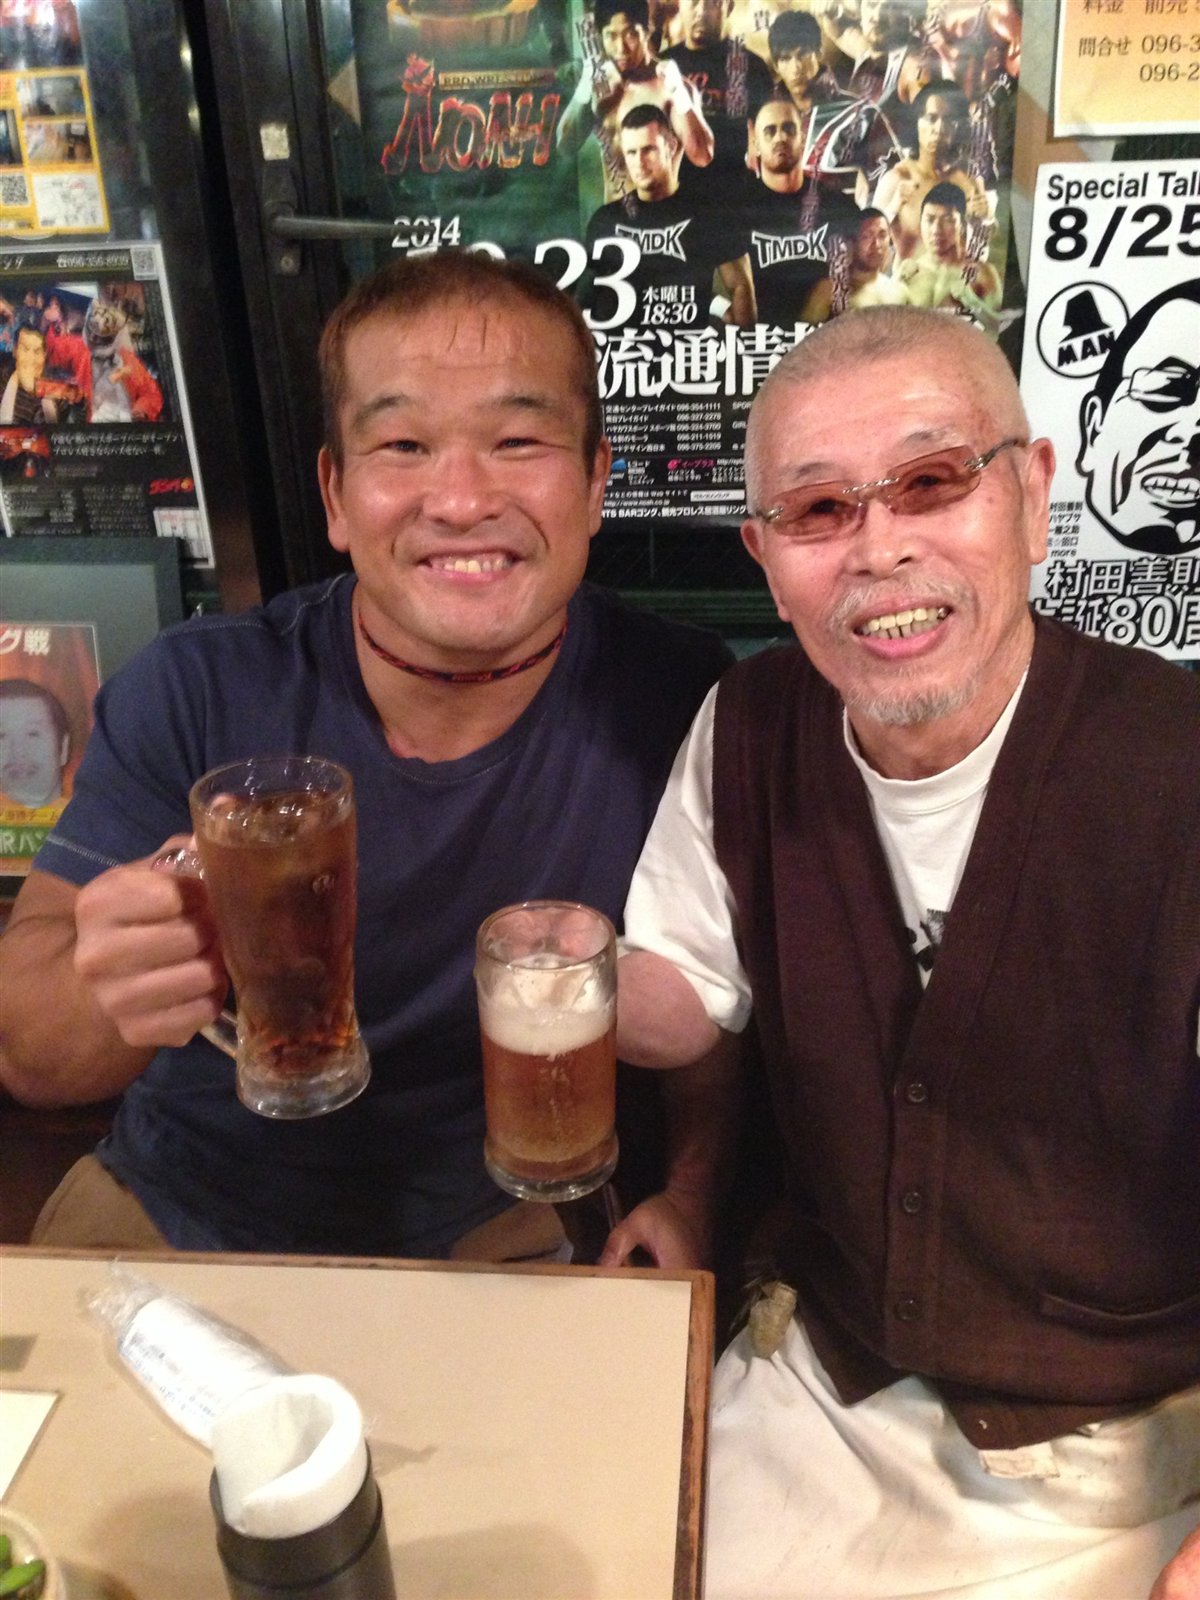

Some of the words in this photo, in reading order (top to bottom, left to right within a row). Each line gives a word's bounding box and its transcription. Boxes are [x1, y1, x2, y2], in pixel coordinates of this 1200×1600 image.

[1078, 35, 1132, 57] 問合せ
[1047, 173, 1149, 204] Special
[391, 215, 461, 248] 2014
[751, 222, 829, 269] TMDK
[1044, 204, 1200, 268] 8/25
[640, 302, 698, 326] 18:30
[1056, 330, 1117, 368] MAN
[1050, 549, 1077, 558] more
